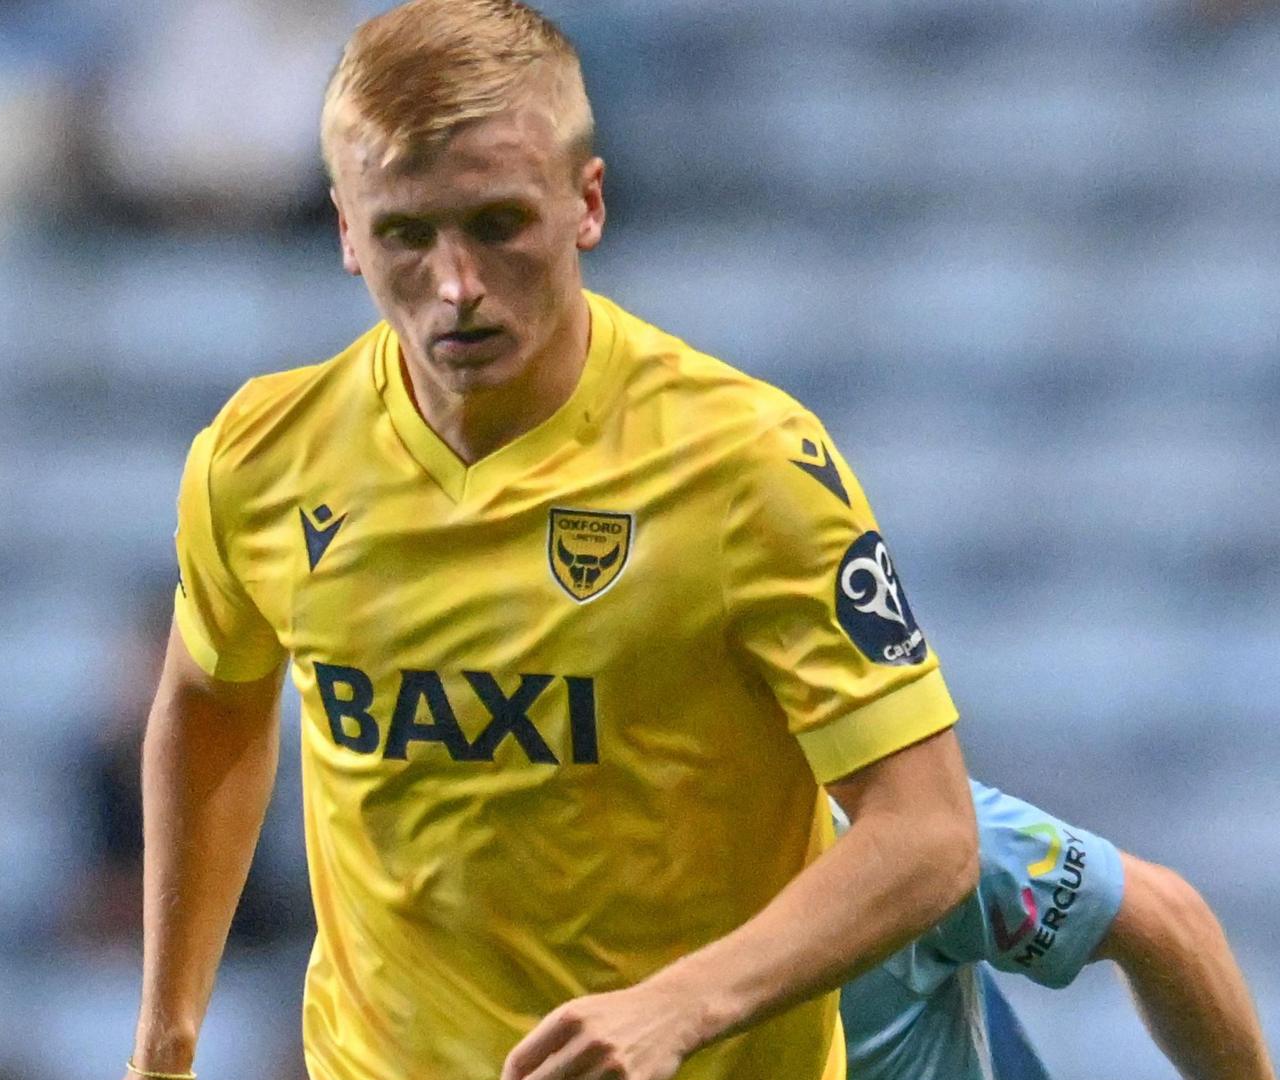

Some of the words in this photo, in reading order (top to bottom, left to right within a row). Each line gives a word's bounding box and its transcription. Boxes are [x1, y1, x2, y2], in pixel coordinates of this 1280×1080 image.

[559, 518, 623, 535] OXFORD
[313, 661, 599, 765] BAXI
[1014, 828, 1087, 968] MERCURY
